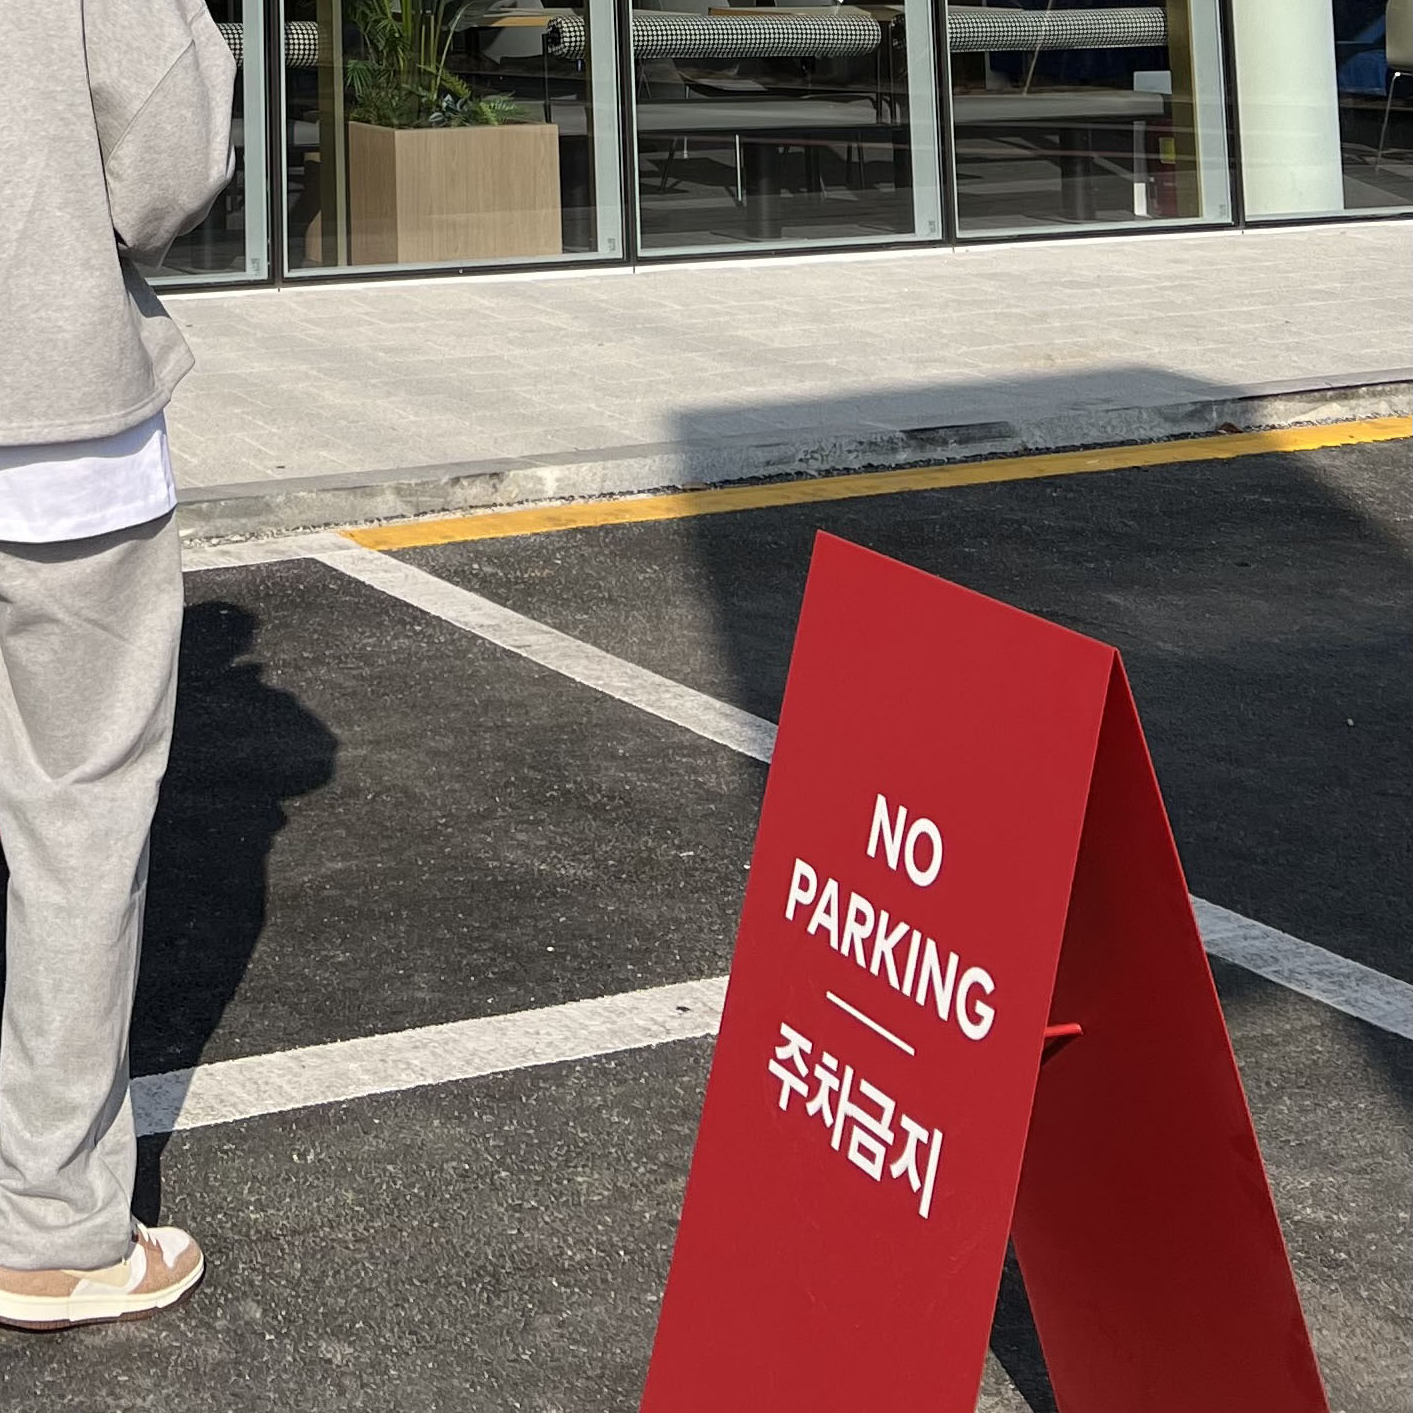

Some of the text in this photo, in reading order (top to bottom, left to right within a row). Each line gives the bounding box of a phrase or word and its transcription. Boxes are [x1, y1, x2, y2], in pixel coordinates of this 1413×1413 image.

[866, 793, 943, 887] NO
[785, 858, 996, 1041] PARKING
[768, 1022, 943, 1219] 주차금지
